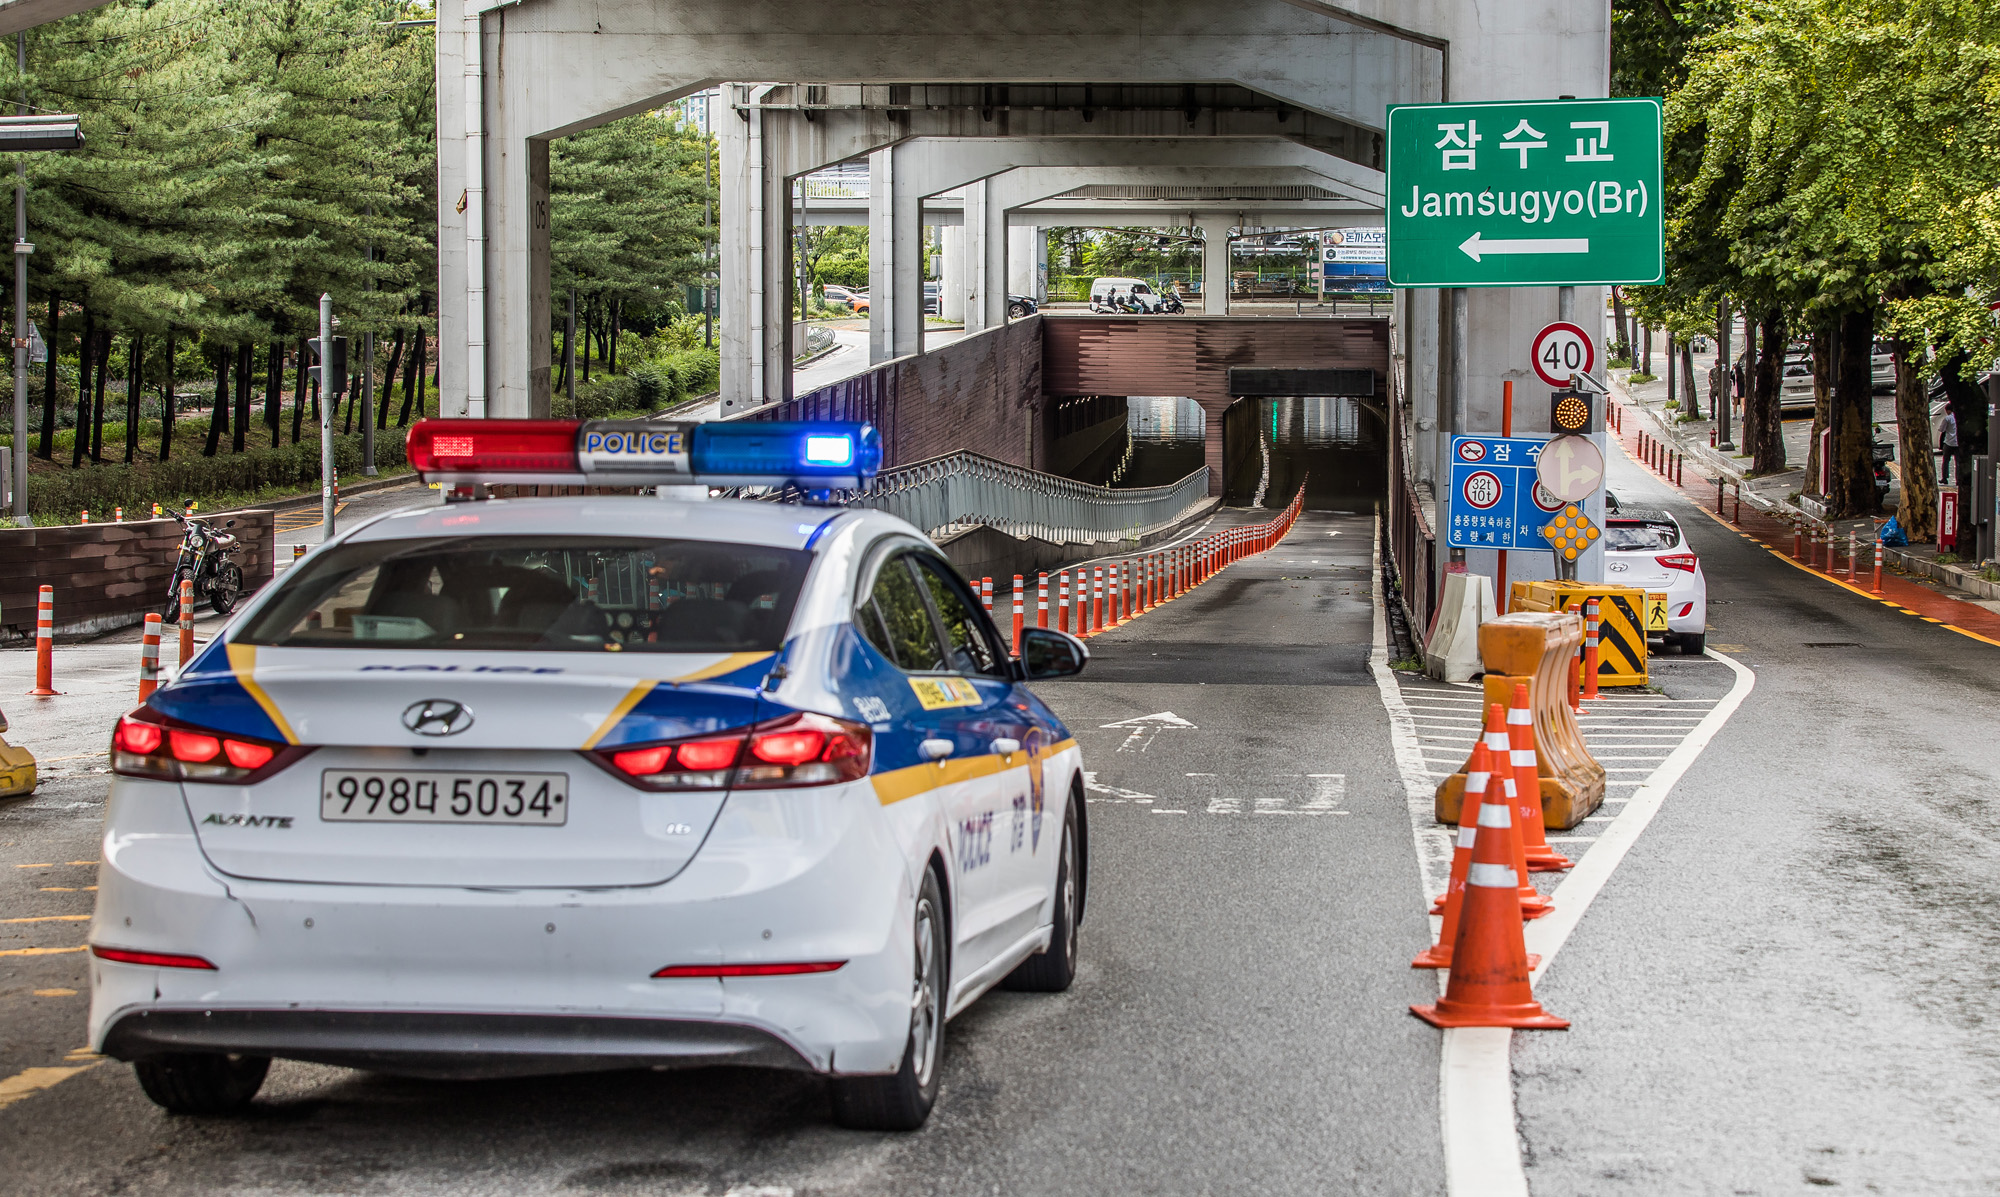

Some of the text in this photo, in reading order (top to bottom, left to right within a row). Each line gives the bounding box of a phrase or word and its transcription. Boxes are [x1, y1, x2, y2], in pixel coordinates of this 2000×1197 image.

[536, 201, 546, 229] 05
[1401, 180, 1648, 223] Jamsugyo(Br)
[1543, 341, 1581, 370] 40
[586, 432, 683, 454] POLICE
[337, 776, 552, 818] 998다 5034
[202, 813, 295, 829] AVANTE
